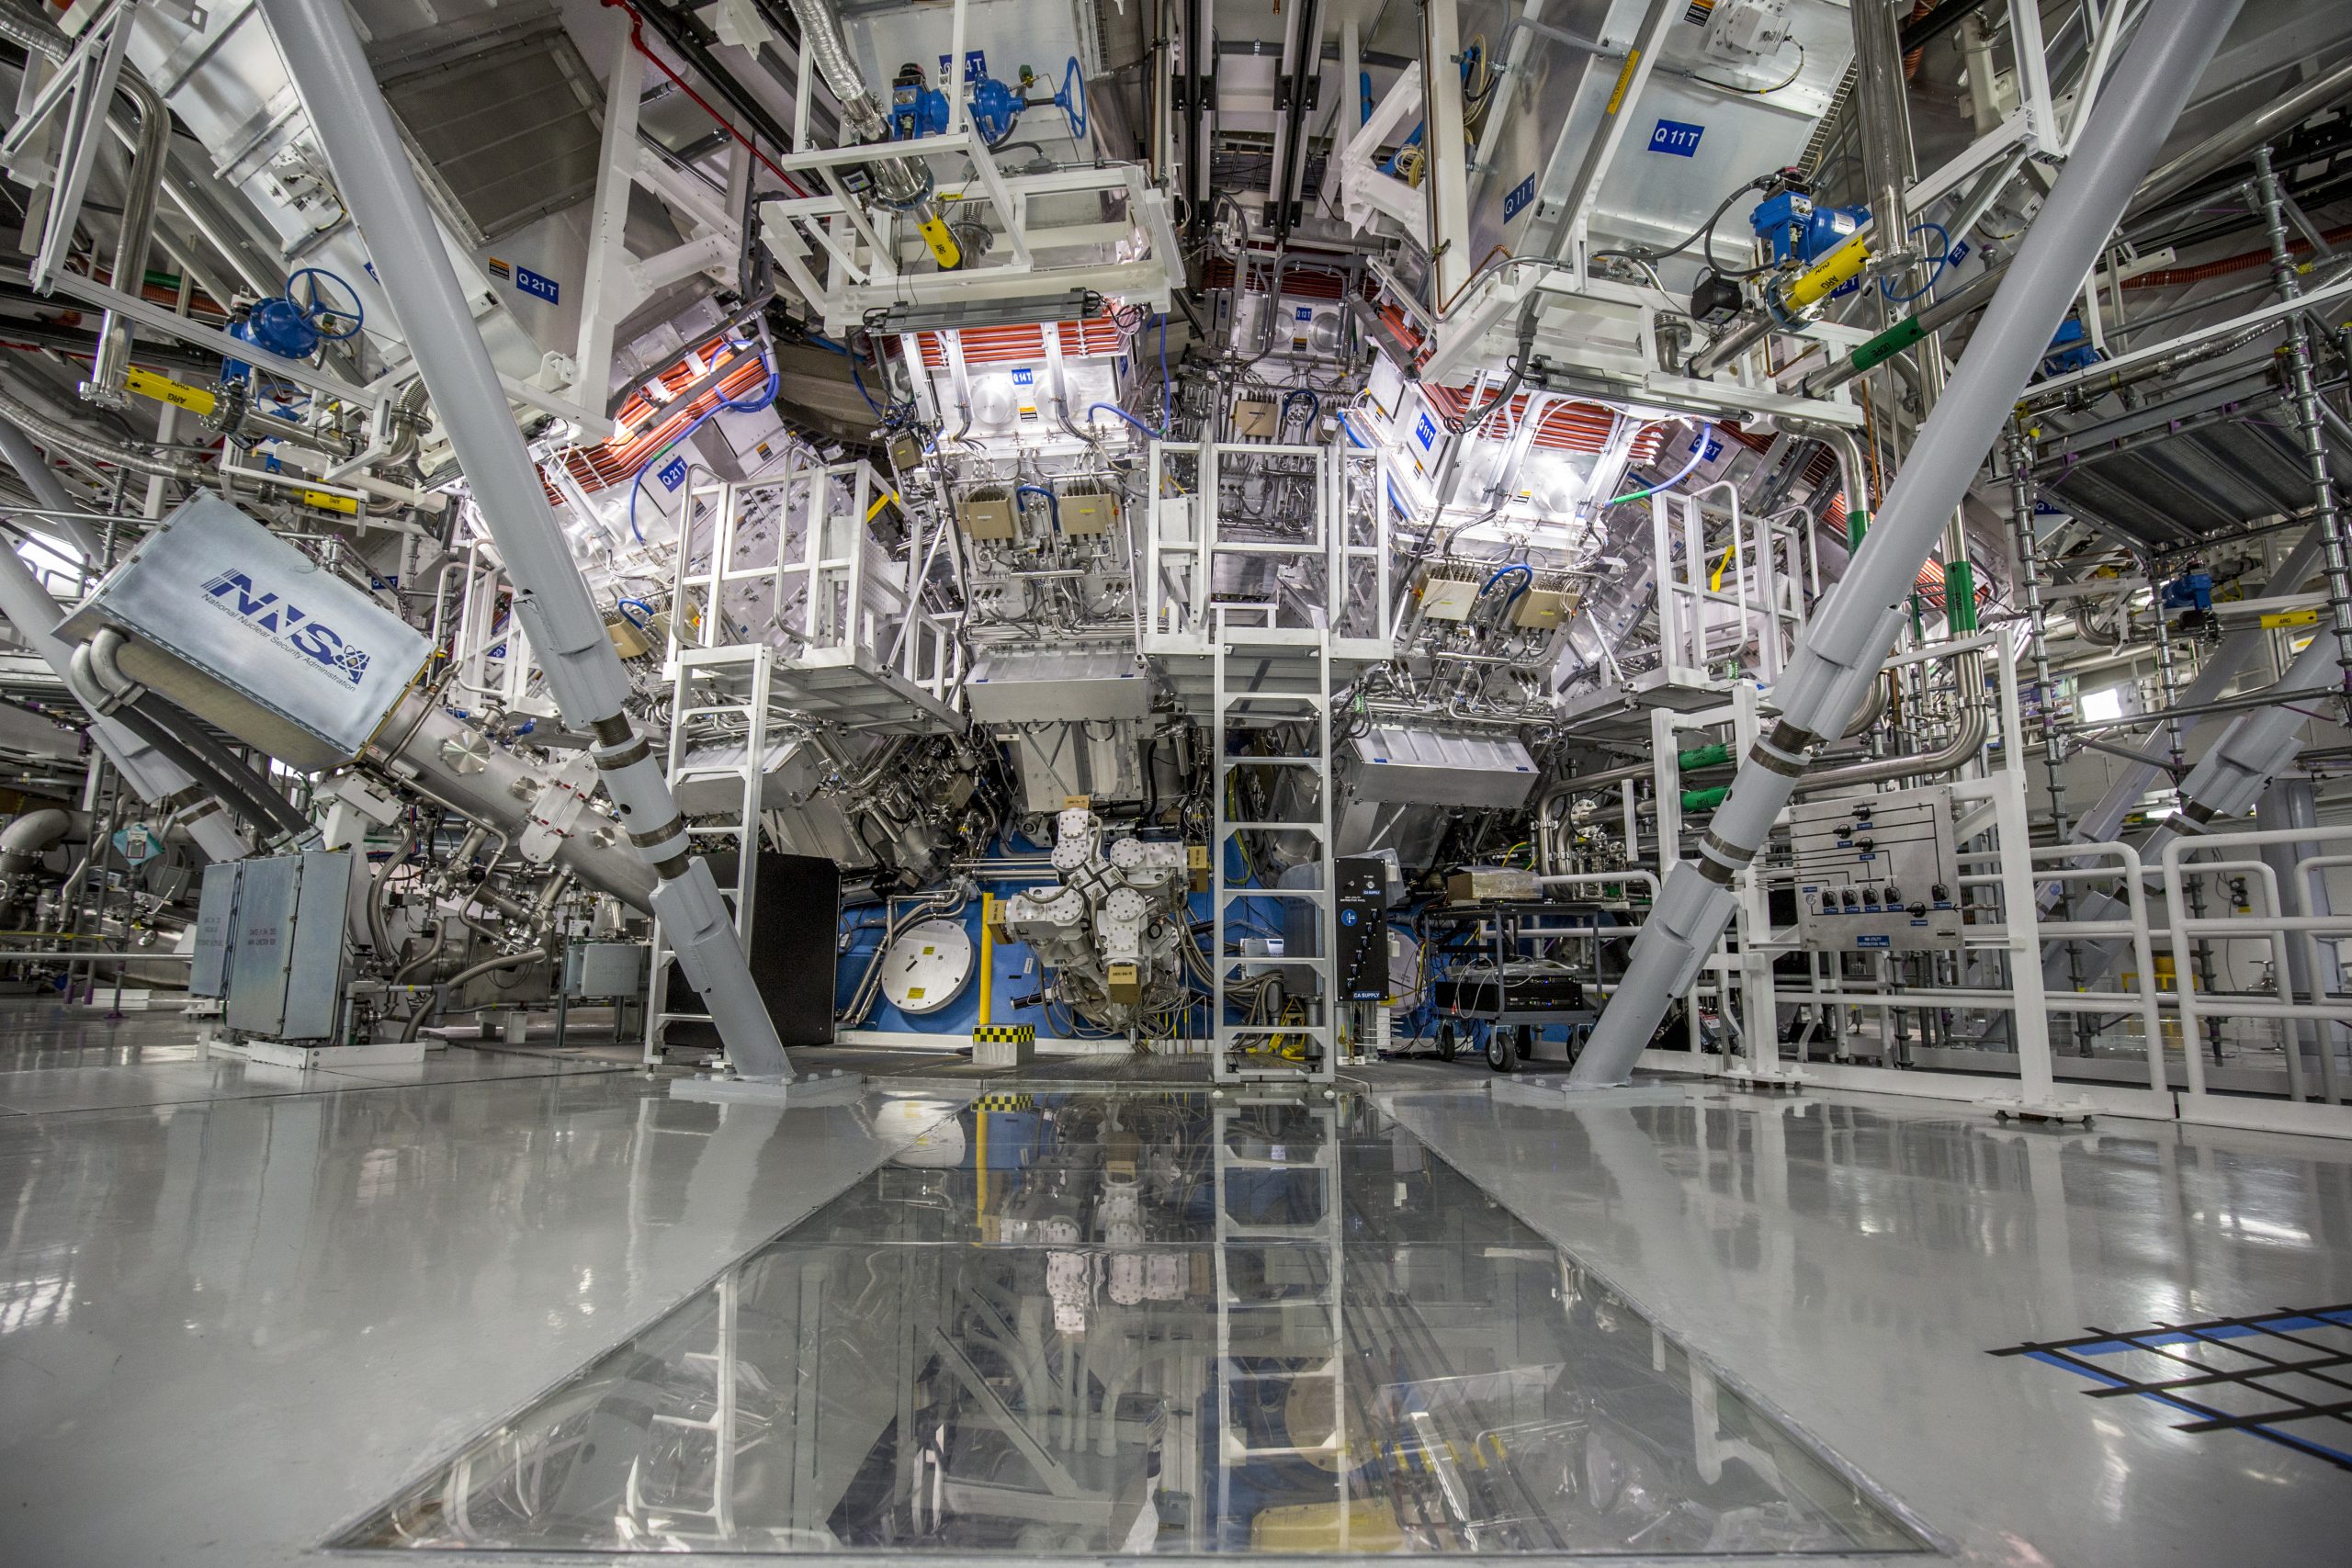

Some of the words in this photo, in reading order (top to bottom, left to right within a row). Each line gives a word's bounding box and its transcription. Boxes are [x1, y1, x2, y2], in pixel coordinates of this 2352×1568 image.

[973, 58, 982, 72] T
[1655, 128, 1668, 143] Q
[1505, 198, 1514, 215] Q
[519, 273, 529, 287] Q
[1821, 275, 1839, 289] ARG
[1013, 373, 1019, 382] Q
[167, 391, 187, 405] ARG
[1419, 419, 1425, 432] Q
[1693, 438, 1702, 448] Q
[662, 475, 672, 486] Q
[2037, 502, 2045, 511] Q
[2278, 616, 2291, 625] ARG
[201, 593, 239, 618] National
[237, 615, 271, 639] Nuclear
[270, 636, 303, 660] Security
[302, 655, 356, 693] Administration
